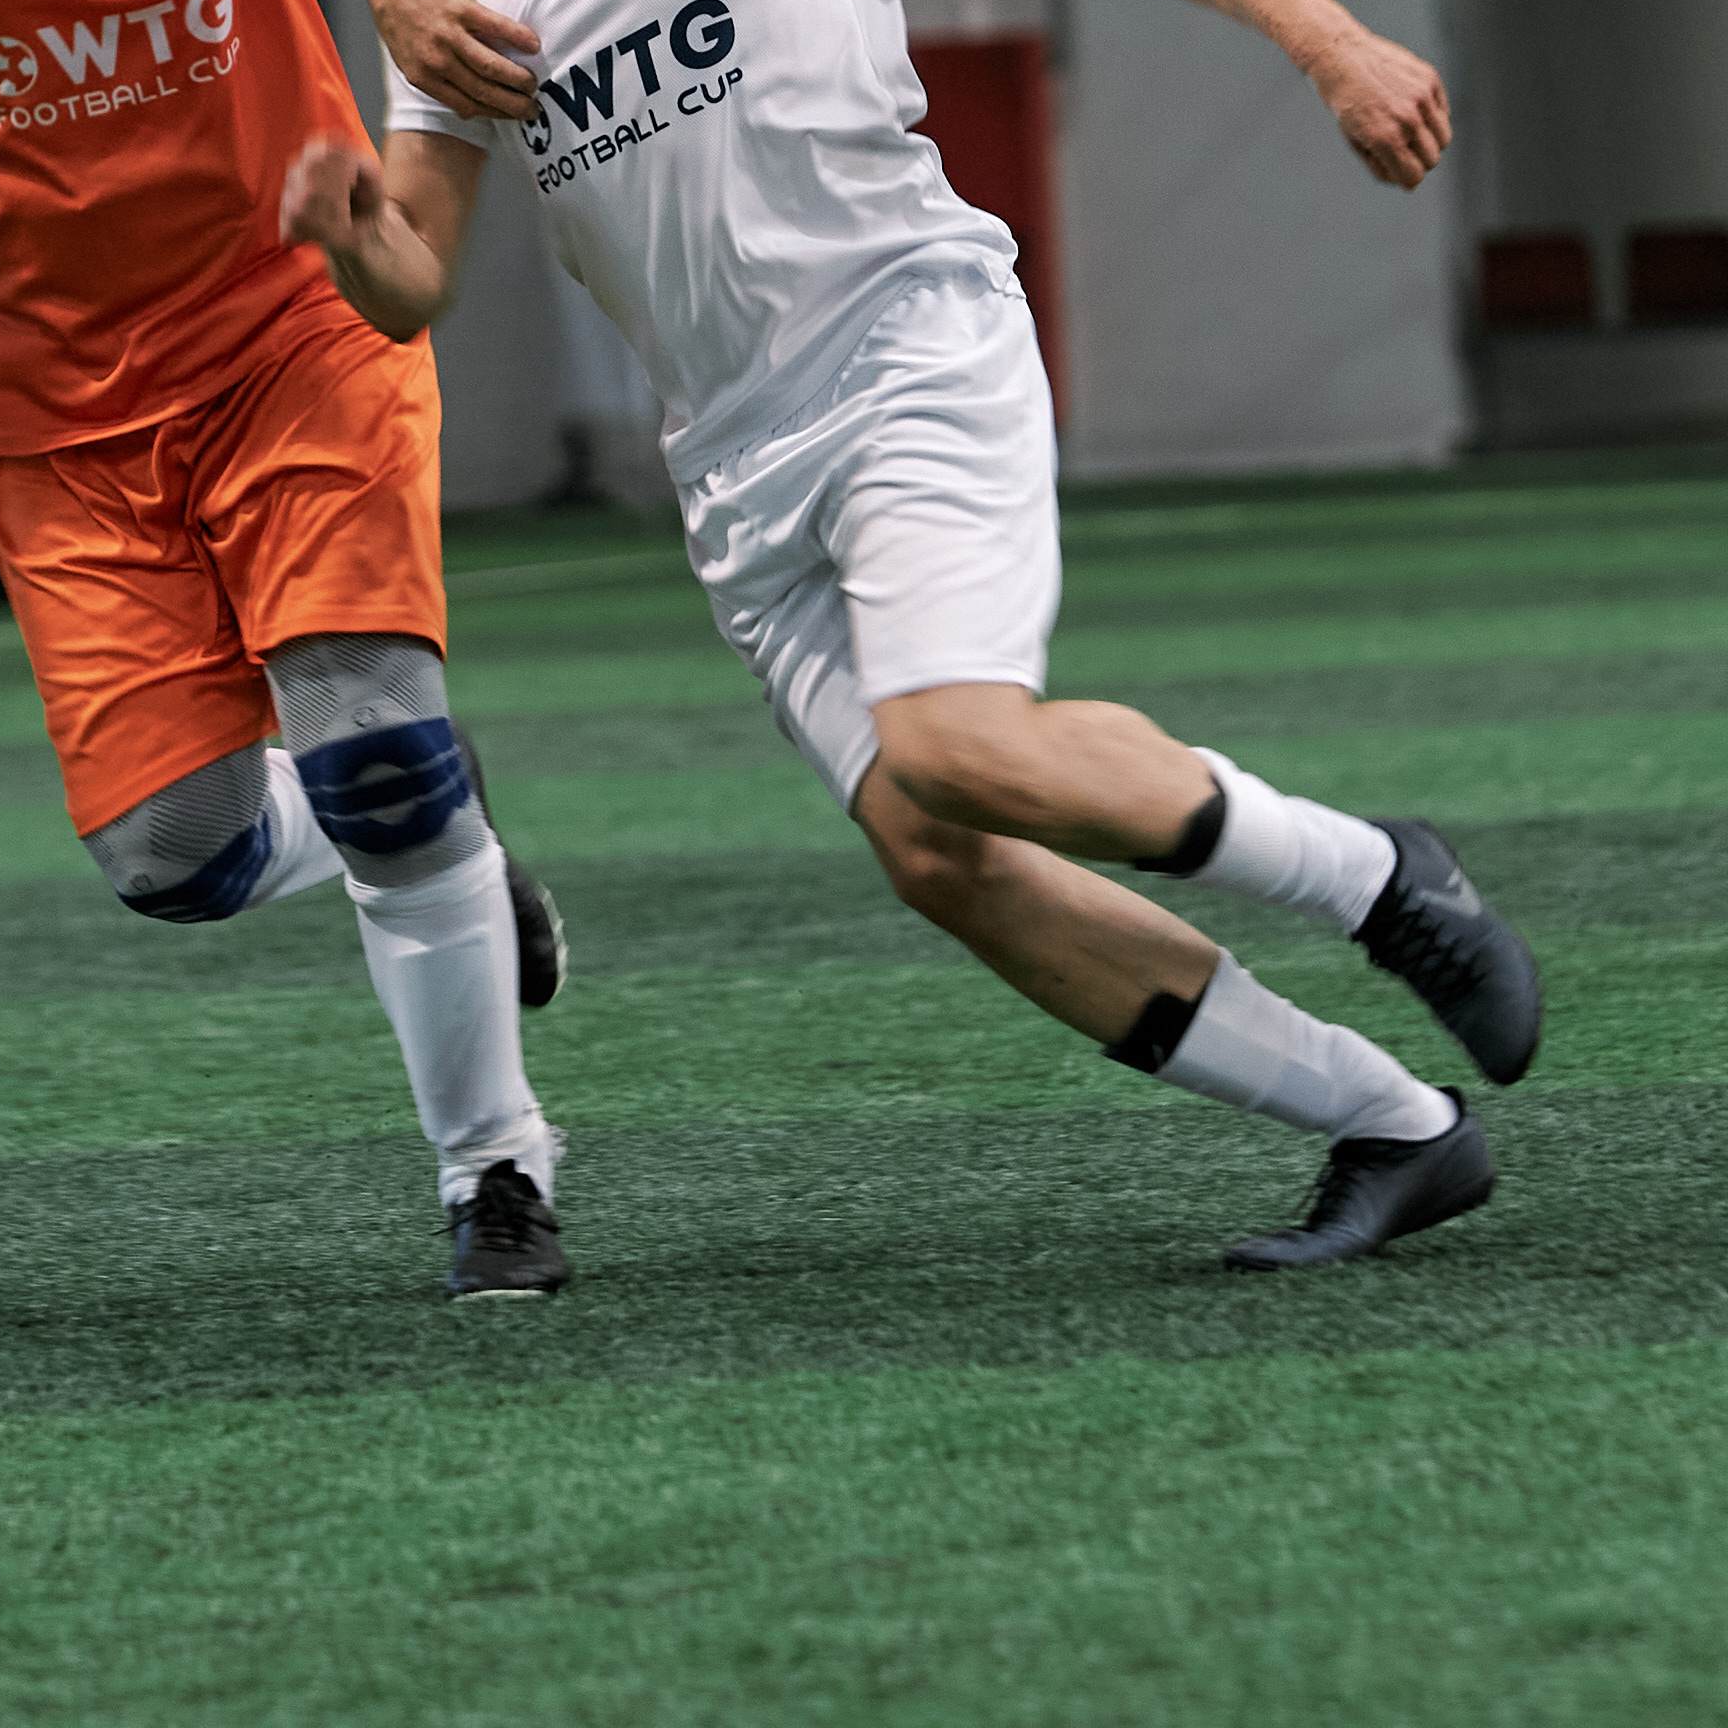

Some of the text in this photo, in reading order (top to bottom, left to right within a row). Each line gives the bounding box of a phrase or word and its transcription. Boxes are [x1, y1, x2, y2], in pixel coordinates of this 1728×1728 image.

[188, 36, 241, 83] CUP
[536, 67, 744, 194] FOOTBALL CUP
